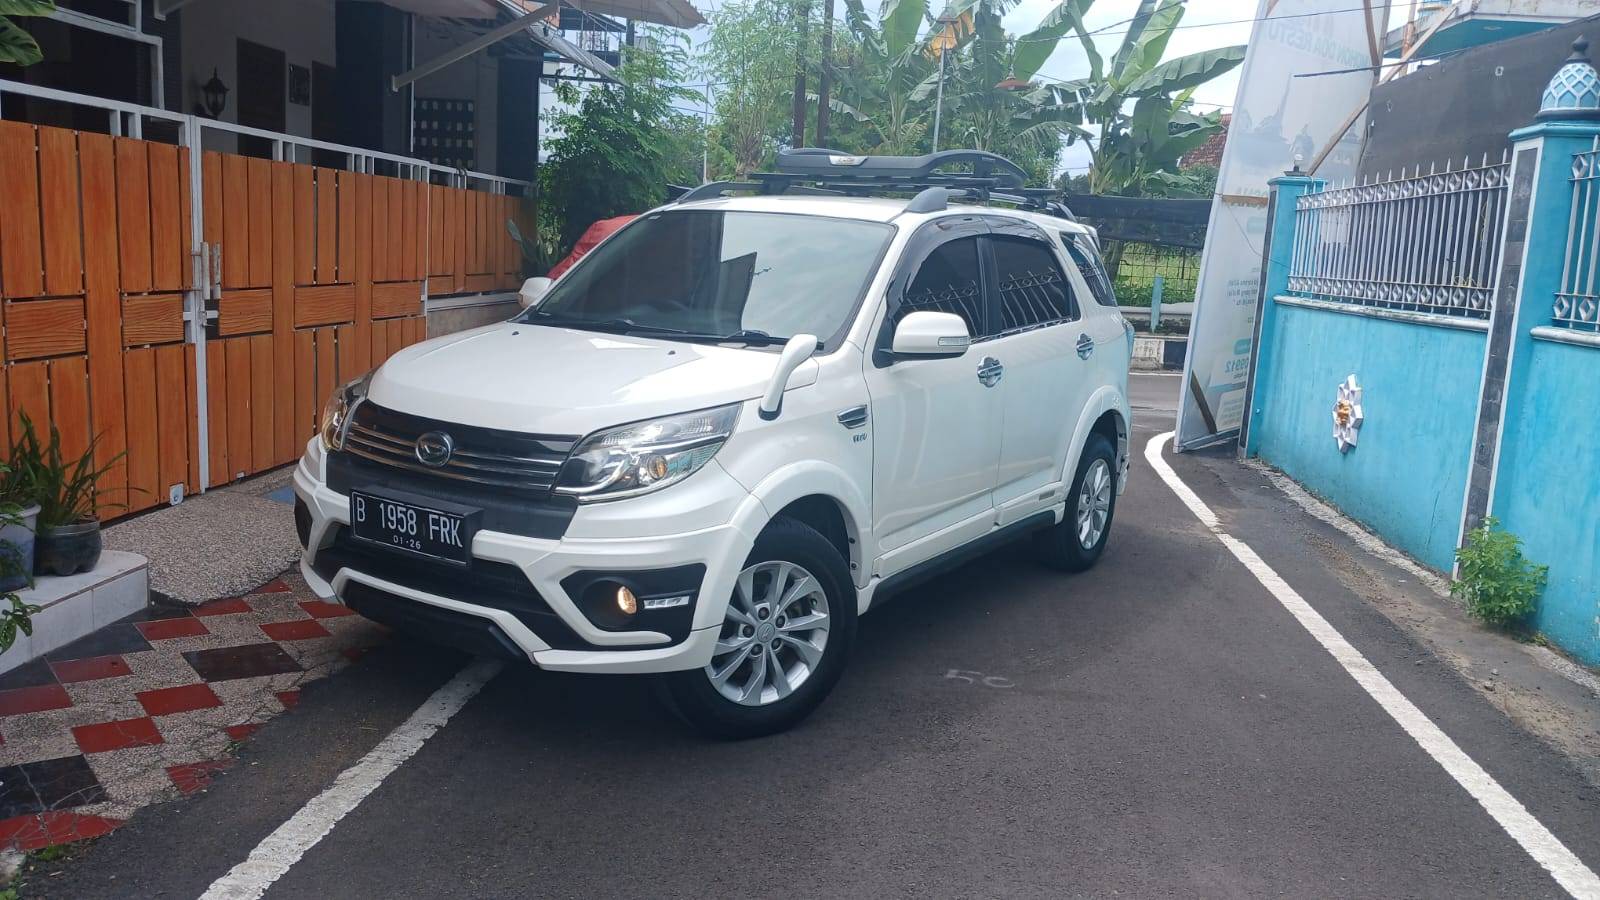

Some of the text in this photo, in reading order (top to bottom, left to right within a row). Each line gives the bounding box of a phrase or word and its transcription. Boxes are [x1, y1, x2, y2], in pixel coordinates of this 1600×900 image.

[356, 496, 463, 548] B 1958 FRK
